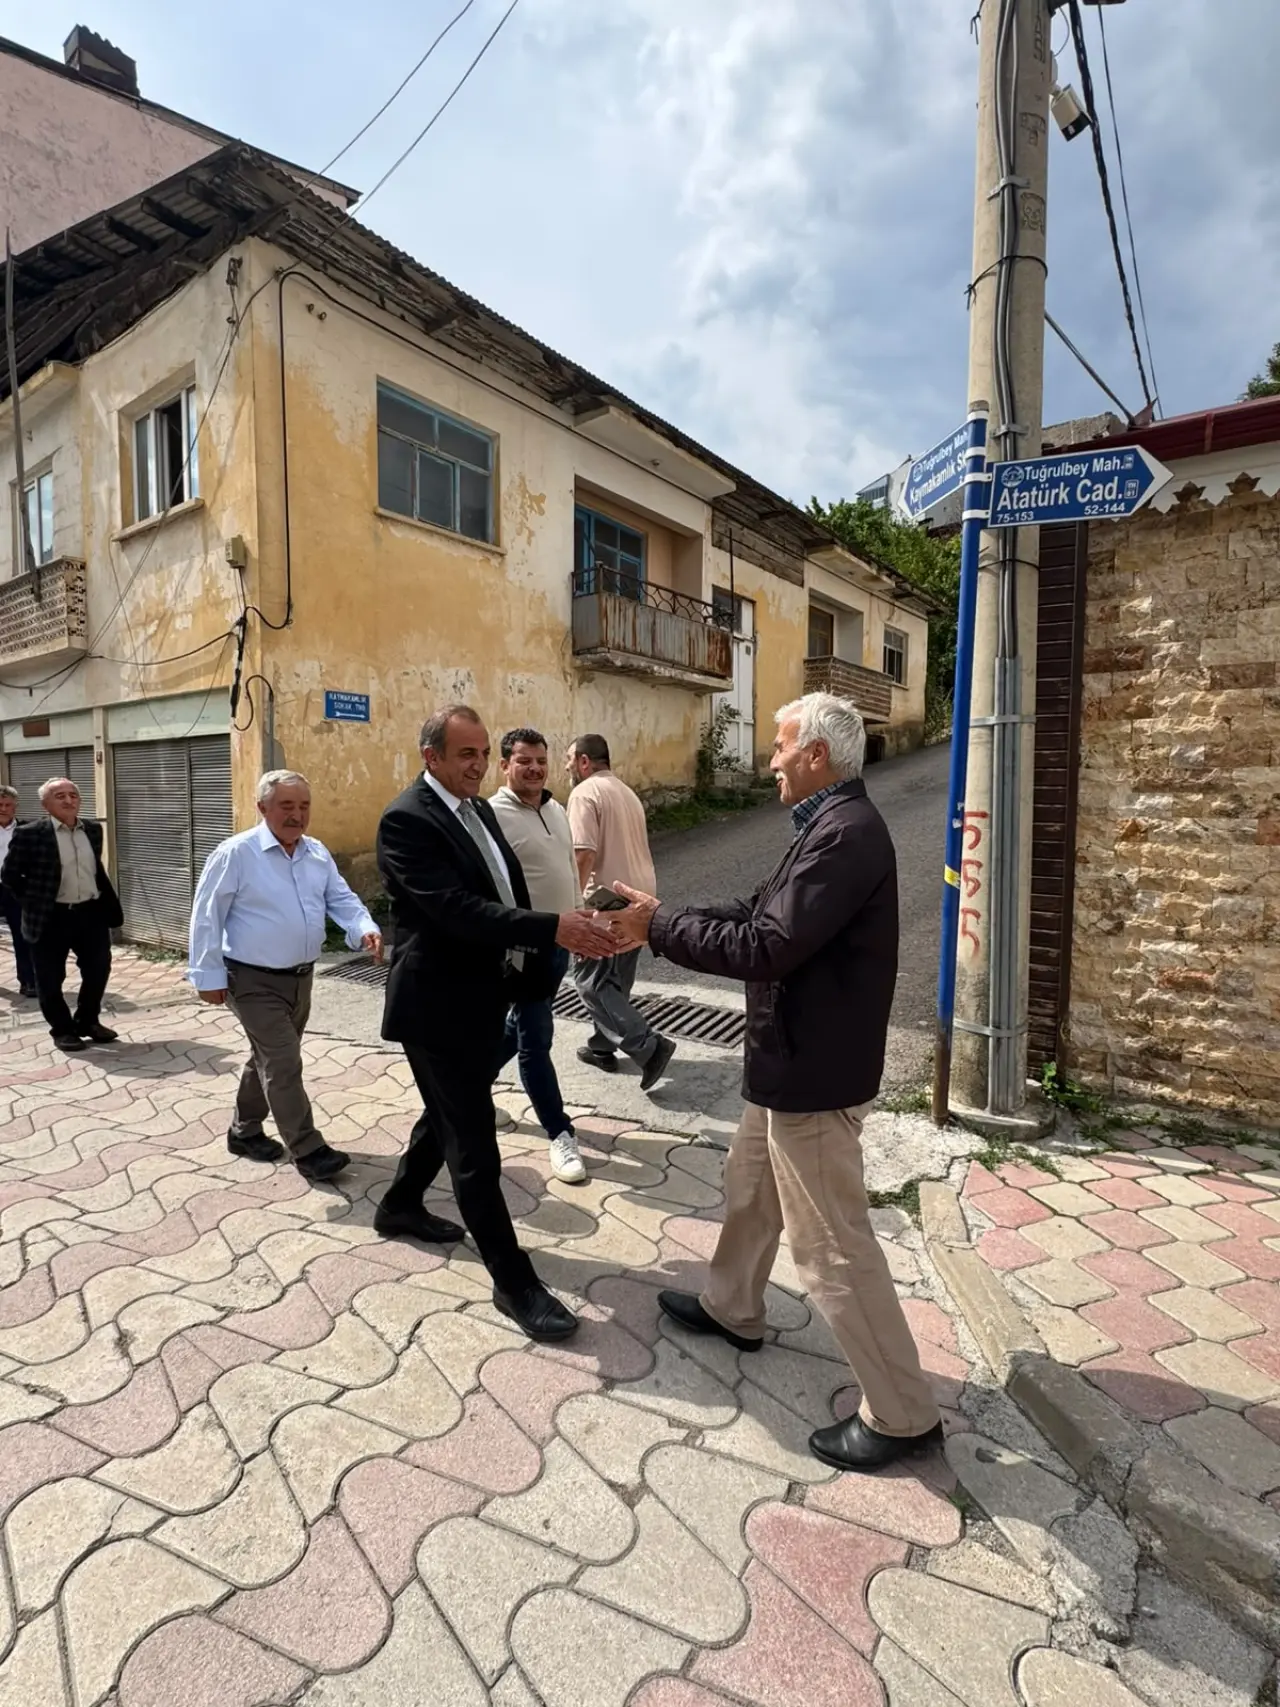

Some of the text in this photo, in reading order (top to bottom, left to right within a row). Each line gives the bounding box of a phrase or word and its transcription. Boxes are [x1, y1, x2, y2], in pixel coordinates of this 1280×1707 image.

[1024, 461, 1089, 482] Tuğrulbey
[1092, 455, 1125, 473] Mah.
[910, 459, 956, 508] Kaymakamlık
[997, 476, 1123, 511] Atatürk Cad.
[997, 510, 1034, 523] 75-153
[1084, 502, 1125, 515] 52-144
